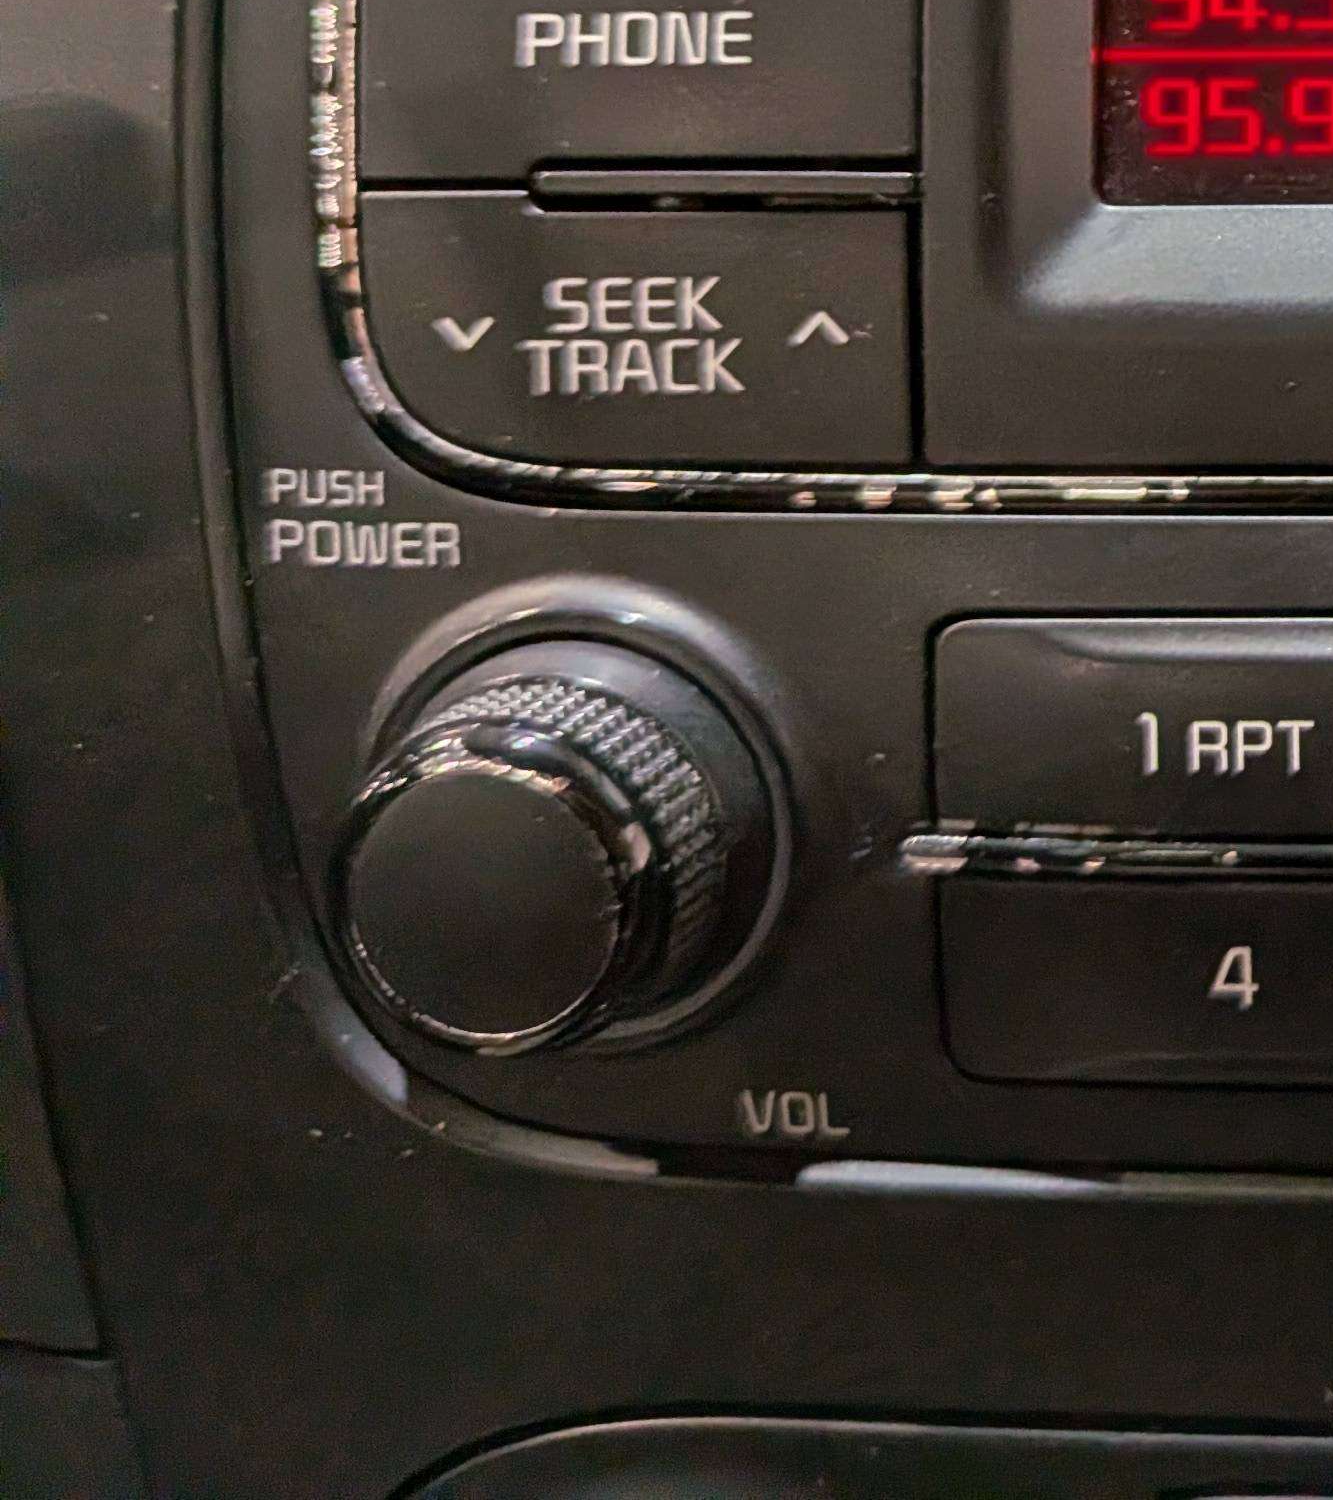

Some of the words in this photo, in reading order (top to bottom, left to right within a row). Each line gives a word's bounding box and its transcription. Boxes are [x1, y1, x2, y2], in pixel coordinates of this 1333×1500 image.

[513, 10, 754, 67] PHONE
[542, 276, 724, 333] SEEK
[516, 337, 746, 395] TRACK
[267, 467, 385, 507] PUSH
[268, 518, 461, 567] POWER
[1134, 710, 1160, 775] 1
[1186, 718, 1315, 778] RPT
[1208, 944, 1260, 1011] 4
[740, 1088, 851, 1138] VOL
